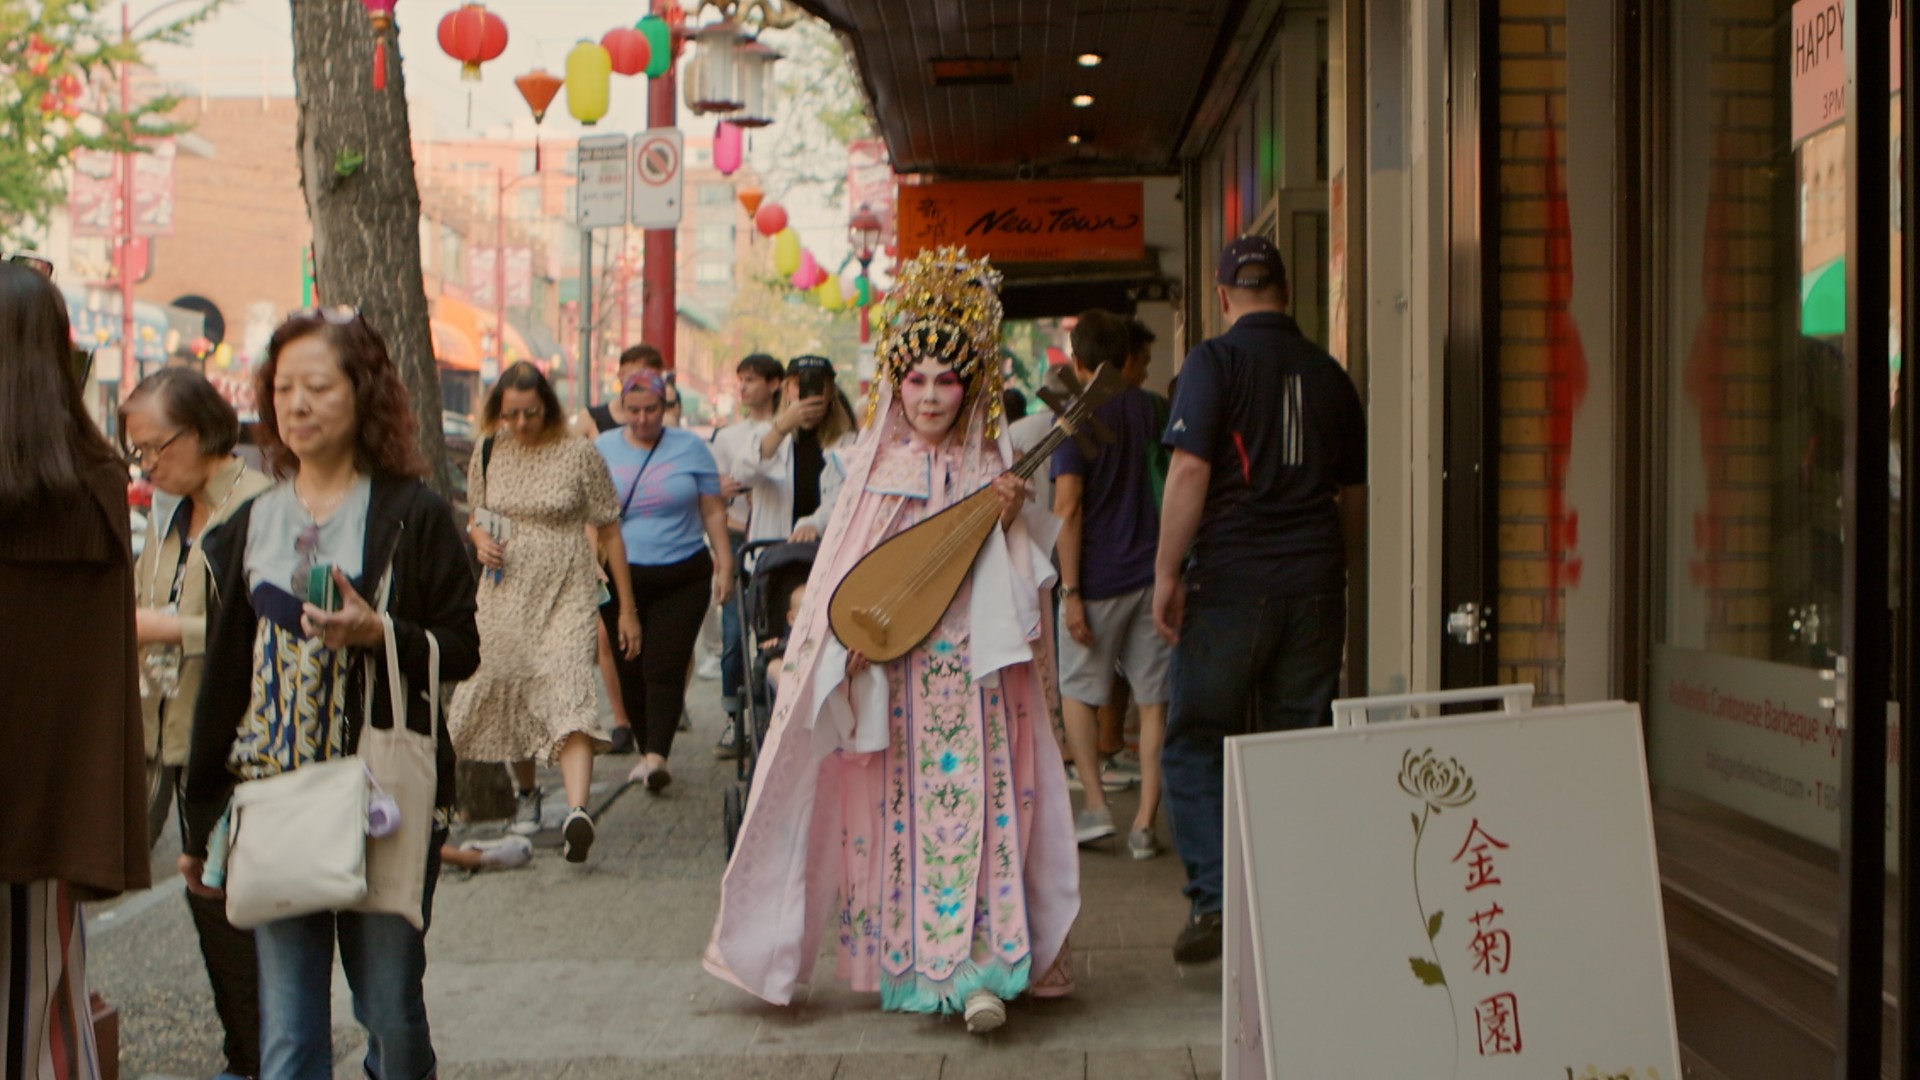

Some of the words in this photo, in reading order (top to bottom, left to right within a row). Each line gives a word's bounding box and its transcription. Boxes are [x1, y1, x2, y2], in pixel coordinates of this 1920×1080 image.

[1796, 1, 1845, 78] HAPPY
[965, 207, 1042, 236] New
[1048, 207, 1139, 235] Town
[1711, 687, 1762, 728] Cantonese
[1765, 699, 1819, 747] Barbeque
[1452, 818, 1522, 1056] 金菊園
